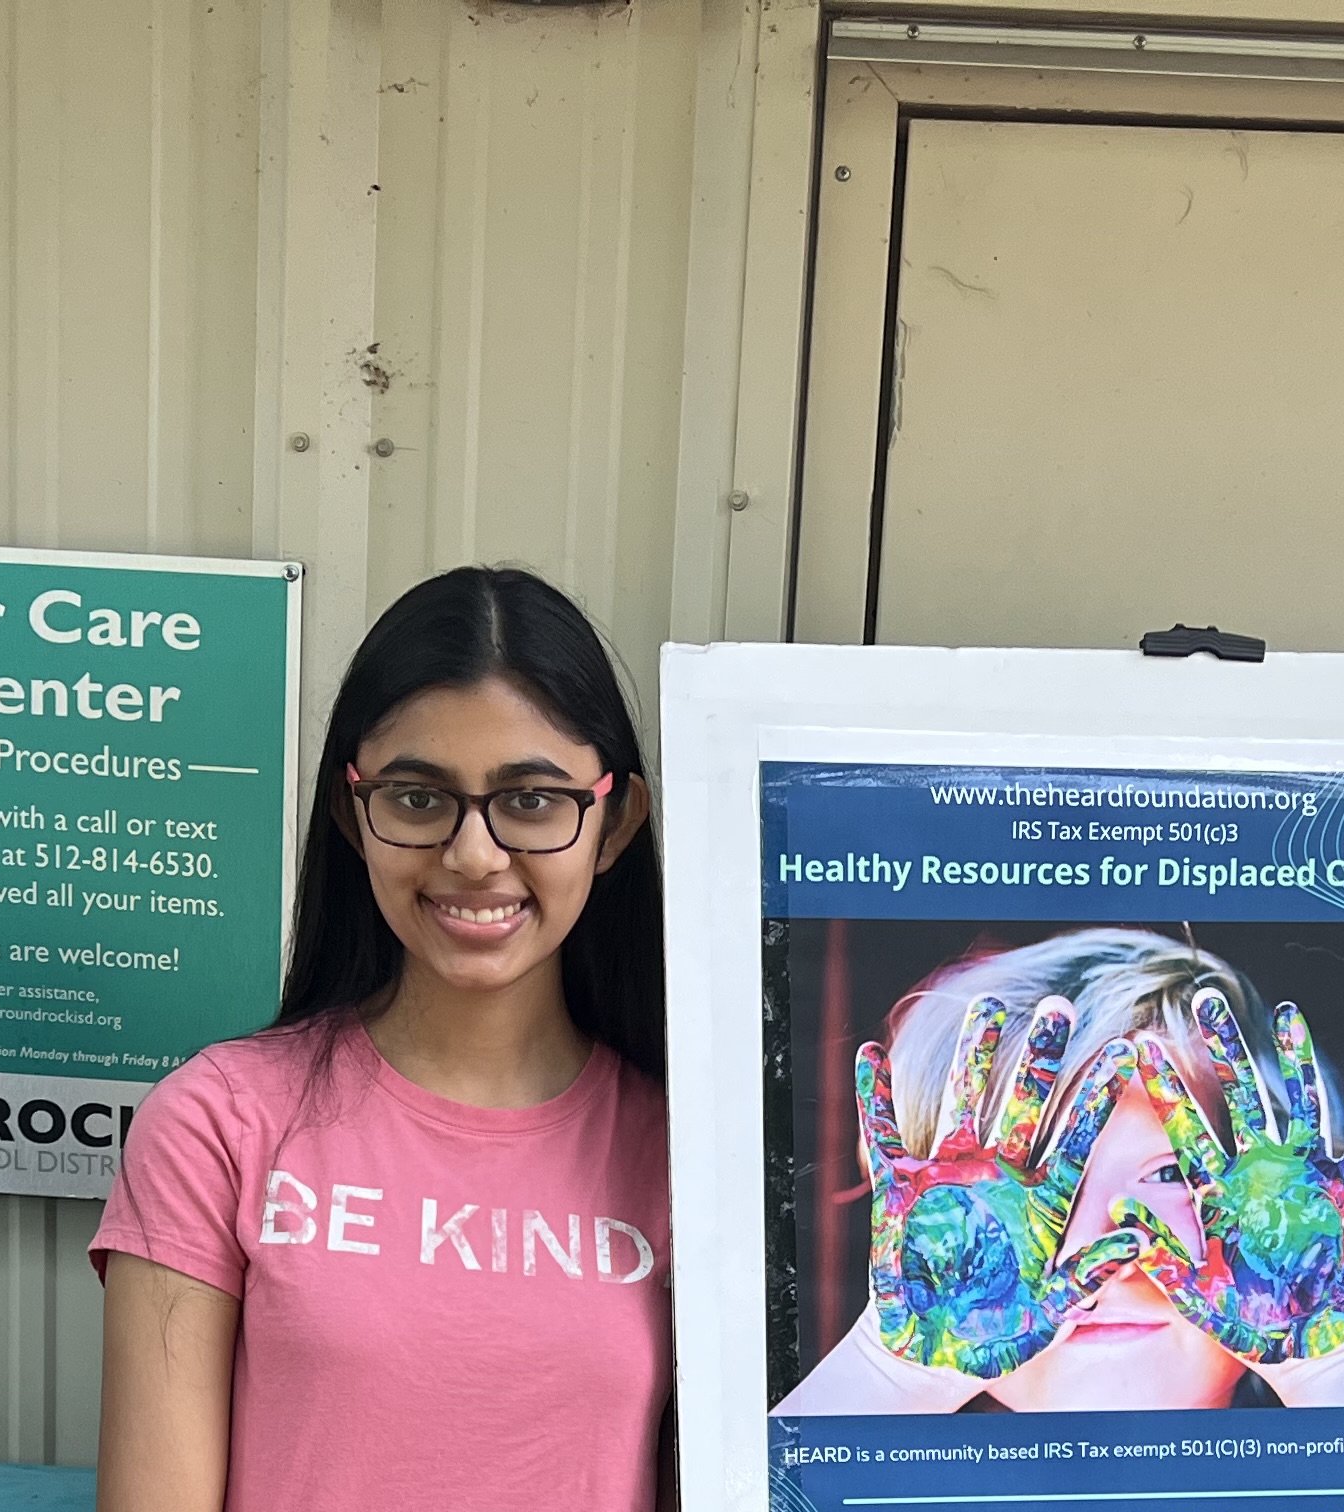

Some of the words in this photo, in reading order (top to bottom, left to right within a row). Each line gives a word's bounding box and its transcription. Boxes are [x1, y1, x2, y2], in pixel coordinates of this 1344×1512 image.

[28, 589, 201, 651] Care
[927, 780, 1320, 817] www.theheardfoundation.org
[54, 813, 68, 831] a
[76, 809, 117, 834] call
[126, 818, 157, 836] or
[164, 818, 218, 841] text
[1012, 820, 1042, 840] IRS
[1047, 821, 1083, 841] Tax
[1088, 821, 1164, 847] Exempt
[1168, 822, 1238, 846] 501(c)3
[1, 847, 27, 867] at
[34, 843, 218, 879] 512-814-6530.
[779, 852, 913, 892] Healthy
[922, 855, 1090, 886] Resources
[1099, 856, 1149, 886] for
[1158, 855, 1318, 894] Displaced
[46, 882, 73, 907] all
[81, 891, 142, 916] your
[150, 889, 225, 917] items.
[9, 944, 50, 963] are
[57, 942, 179, 972] welcome!
[18, 986, 100, 1004] assistance,
[20, 1047, 69, 1063] Monday
[72, 1050, 119, 1067] through
[122, 1053, 158, 1069] Friday
[162, 1056, 169, 1068] 8
[37, 1150, 116, 1176] DISTR
[259, 1170, 383, 1255] BE
[420, 1197, 654, 1284] KIND
[782, 1446, 852, 1467] HEARD
[856, 1446, 870, 1463] is
[875, 1449, 885, 1462] a
[889, 1444, 984, 1464] community
[988, 1443, 1039, 1460] based
[1044, 1442, 1074, 1459] IRS
[1077, 1441, 1110, 1458] Tax
[1113, 1441, 1177, 1460] exempt
[1181, 1438, 1262, 1459] 501(C)(3)
